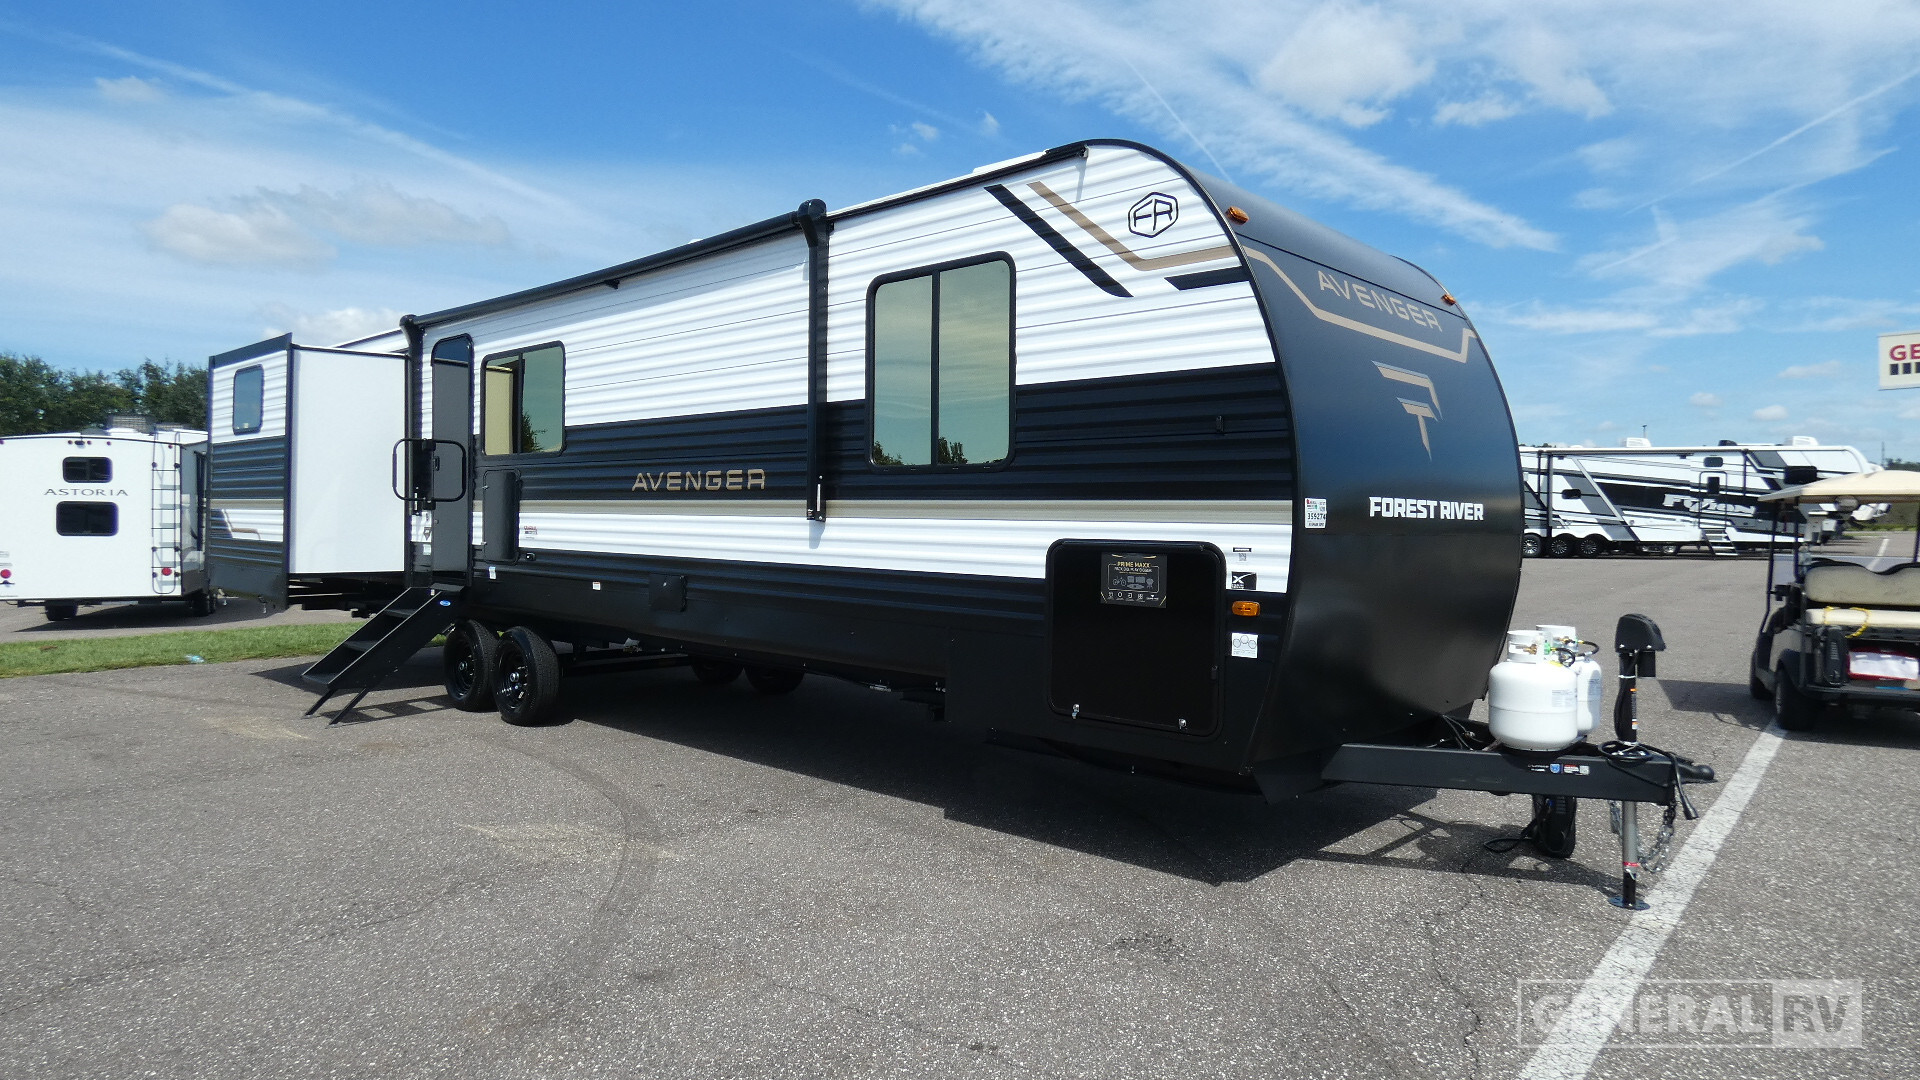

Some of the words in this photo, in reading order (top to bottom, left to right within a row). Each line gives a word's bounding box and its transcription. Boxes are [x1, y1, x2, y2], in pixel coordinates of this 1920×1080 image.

[1318, 270, 1442, 332] AVENGER
[631, 469, 765, 491] AVENGER
[44, 488, 128, 496] ASTORIA
[1369, 496, 1437, 519] FOREST
[1440, 500, 1484, 520] RIVER
